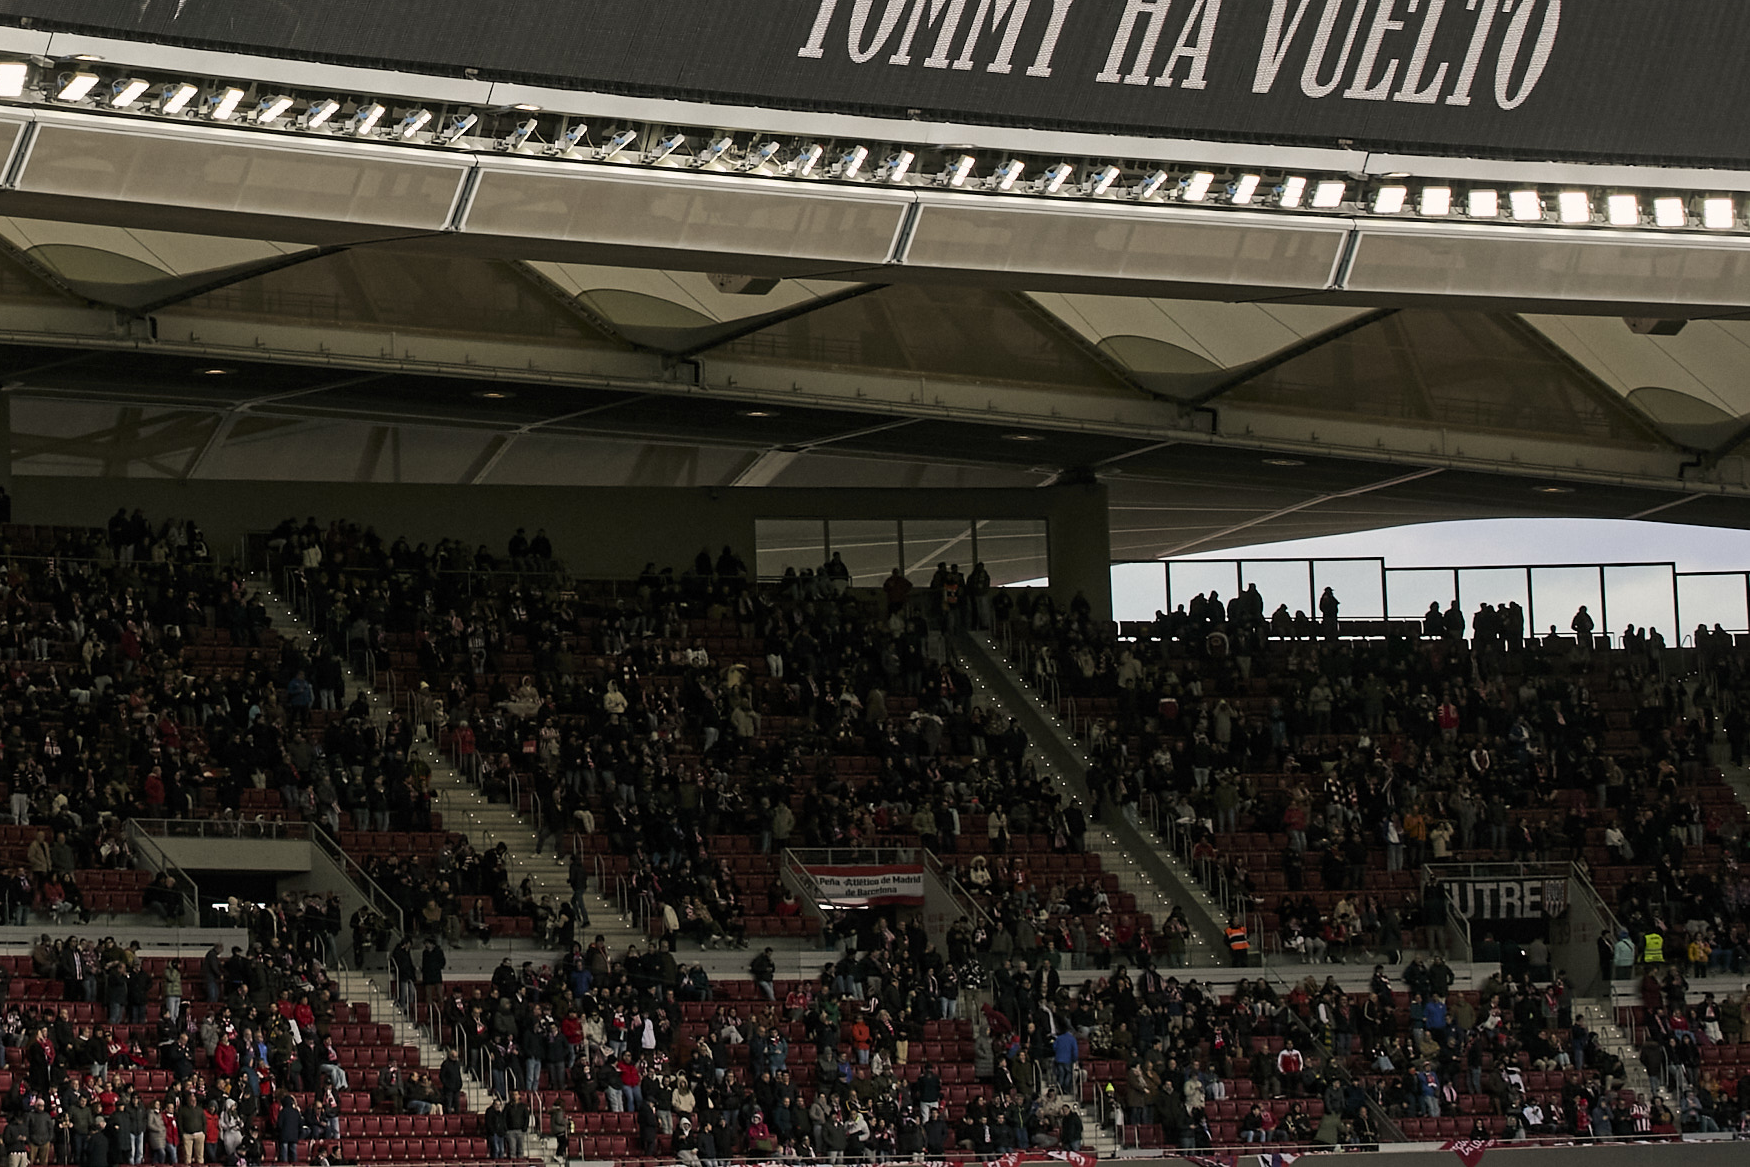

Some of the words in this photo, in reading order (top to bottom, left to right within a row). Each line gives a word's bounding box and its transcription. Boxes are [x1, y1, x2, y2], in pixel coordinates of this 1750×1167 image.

[819, 877, 841, 887] Peña
[880, 876, 891, 885] de
[893, 874, 921, 885] Madrid
[845, 888, 856, 897] de
[857, 886, 898, 897] Barcelona
[1444, 880, 1543, 920] UTRE
